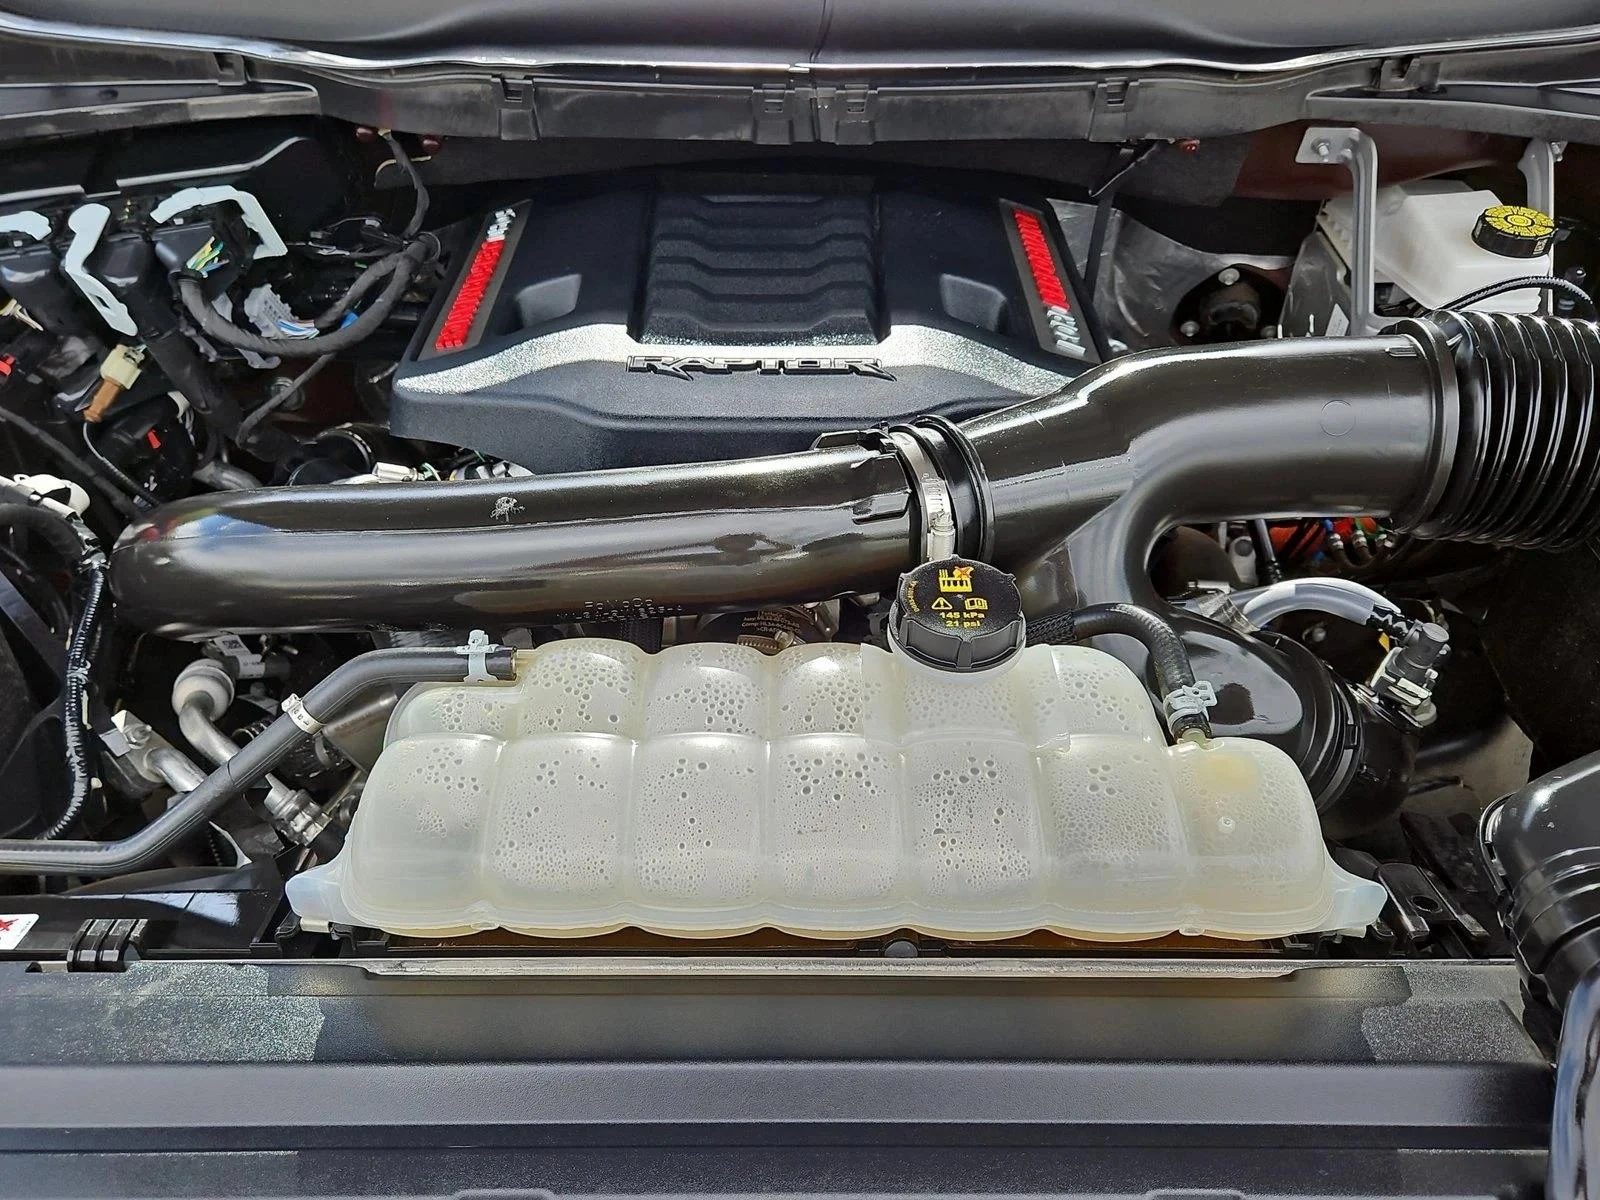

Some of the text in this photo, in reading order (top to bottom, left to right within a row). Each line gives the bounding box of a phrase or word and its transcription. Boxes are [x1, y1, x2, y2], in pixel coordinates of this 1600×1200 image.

[435, 240, 504, 350] PERFORMANCE
[626, 355, 898, 381] RAPTOR
[939, 611, 985, 619] 145 kPa
[945, 620, 981, 630] 21 psi
